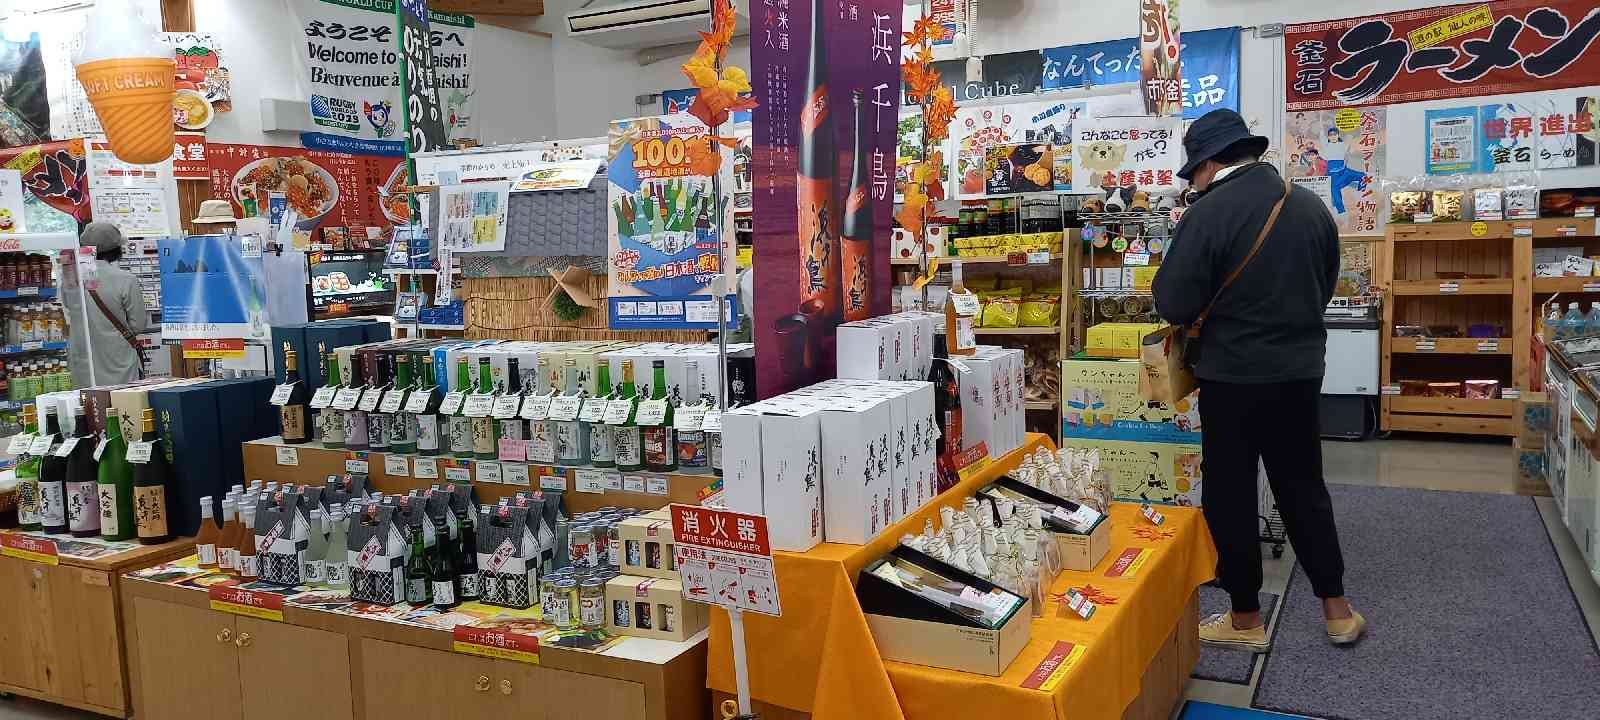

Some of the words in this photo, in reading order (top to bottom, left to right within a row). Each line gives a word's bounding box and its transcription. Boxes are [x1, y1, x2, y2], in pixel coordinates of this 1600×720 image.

[304, 19, 392, 43] ようこそ
[307, 42, 379, 65] Welcome
[380, 50, 397, 65] to
[1329, 6, 1600, 102] ラーメン
[310, 66, 387, 88] Bienvenue
[1292, 39, 1327, 95] 釜石
[113, 71, 165, 90] CREAM
[963, 81, 1020, 100] Cube
[329, 97, 357, 111] RUGBY
[870, 8, 893, 201] 浜千鳥
[681, 510, 757, 542] 消火器
[681, 533, 699, 543] FIRE
[700, 535, 761, 552] EXTINGUISHER
